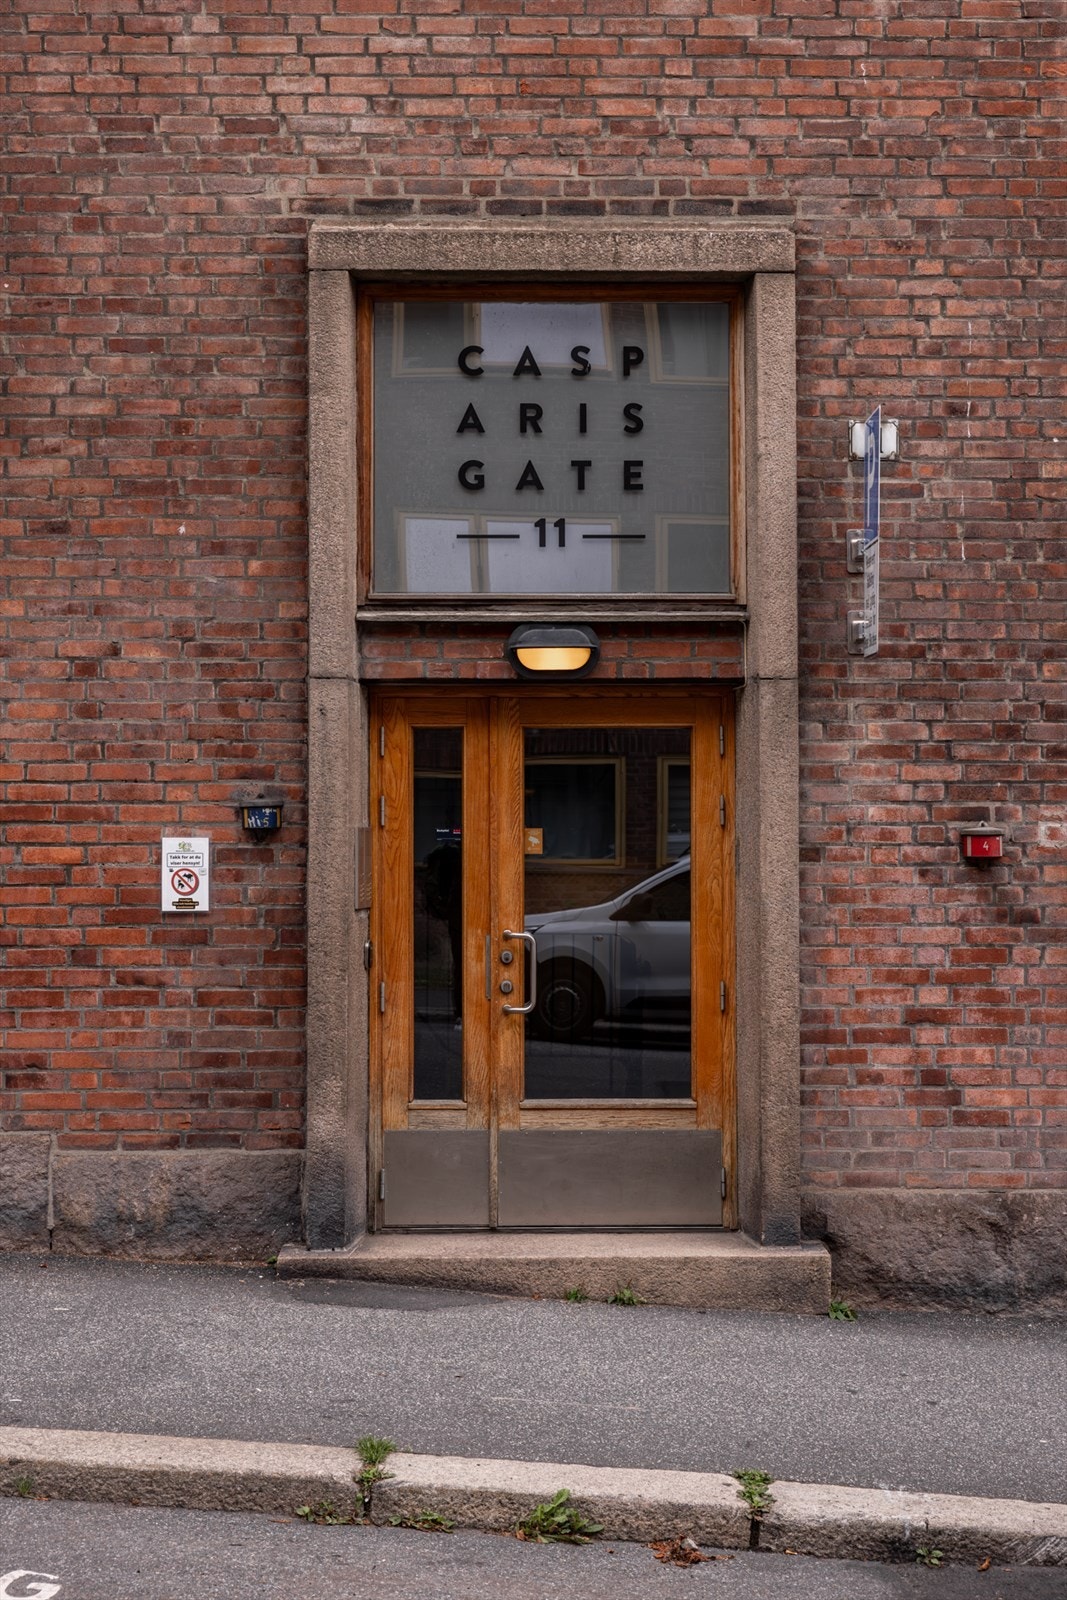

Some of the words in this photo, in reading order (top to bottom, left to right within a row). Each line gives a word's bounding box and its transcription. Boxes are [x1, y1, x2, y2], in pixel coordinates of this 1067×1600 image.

[457, 460, 644, 490] GATE
[534, 518, 566, 548] 11
[983, 841, 989, 851] 4
